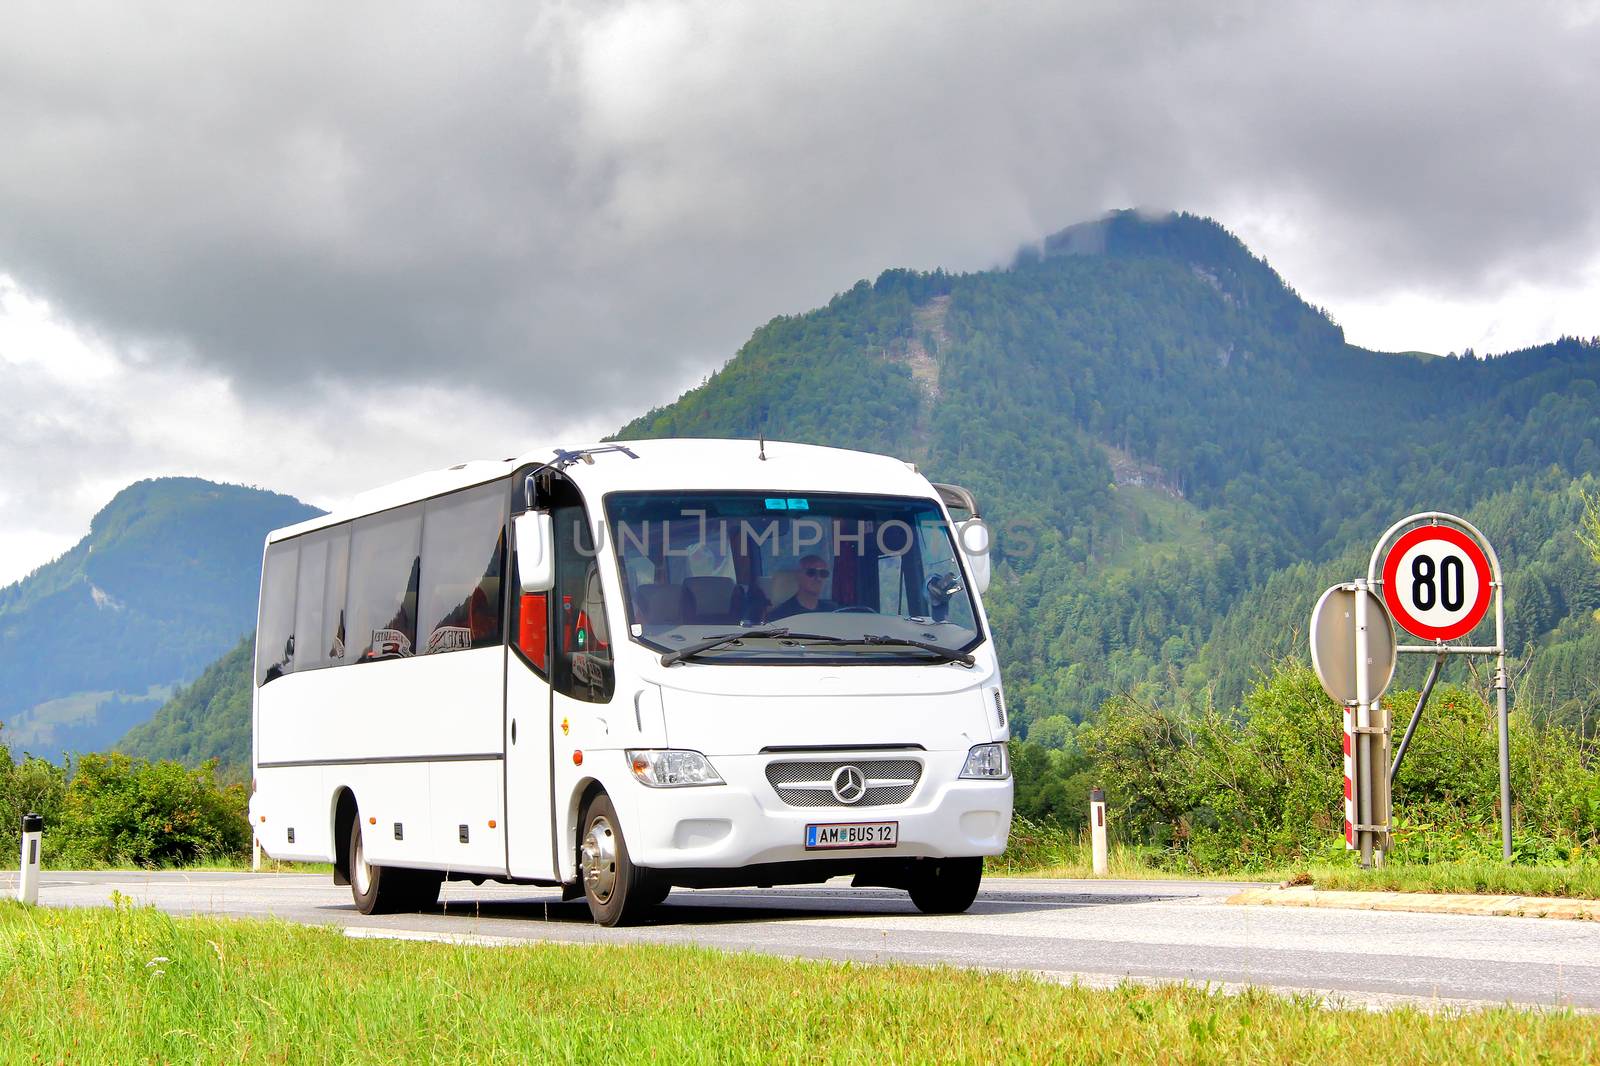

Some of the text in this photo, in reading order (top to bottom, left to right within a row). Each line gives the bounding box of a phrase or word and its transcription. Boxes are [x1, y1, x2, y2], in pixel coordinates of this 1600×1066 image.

[1412, 554, 1464, 612] 80
[819, 826, 892, 843] AM BUS 12
